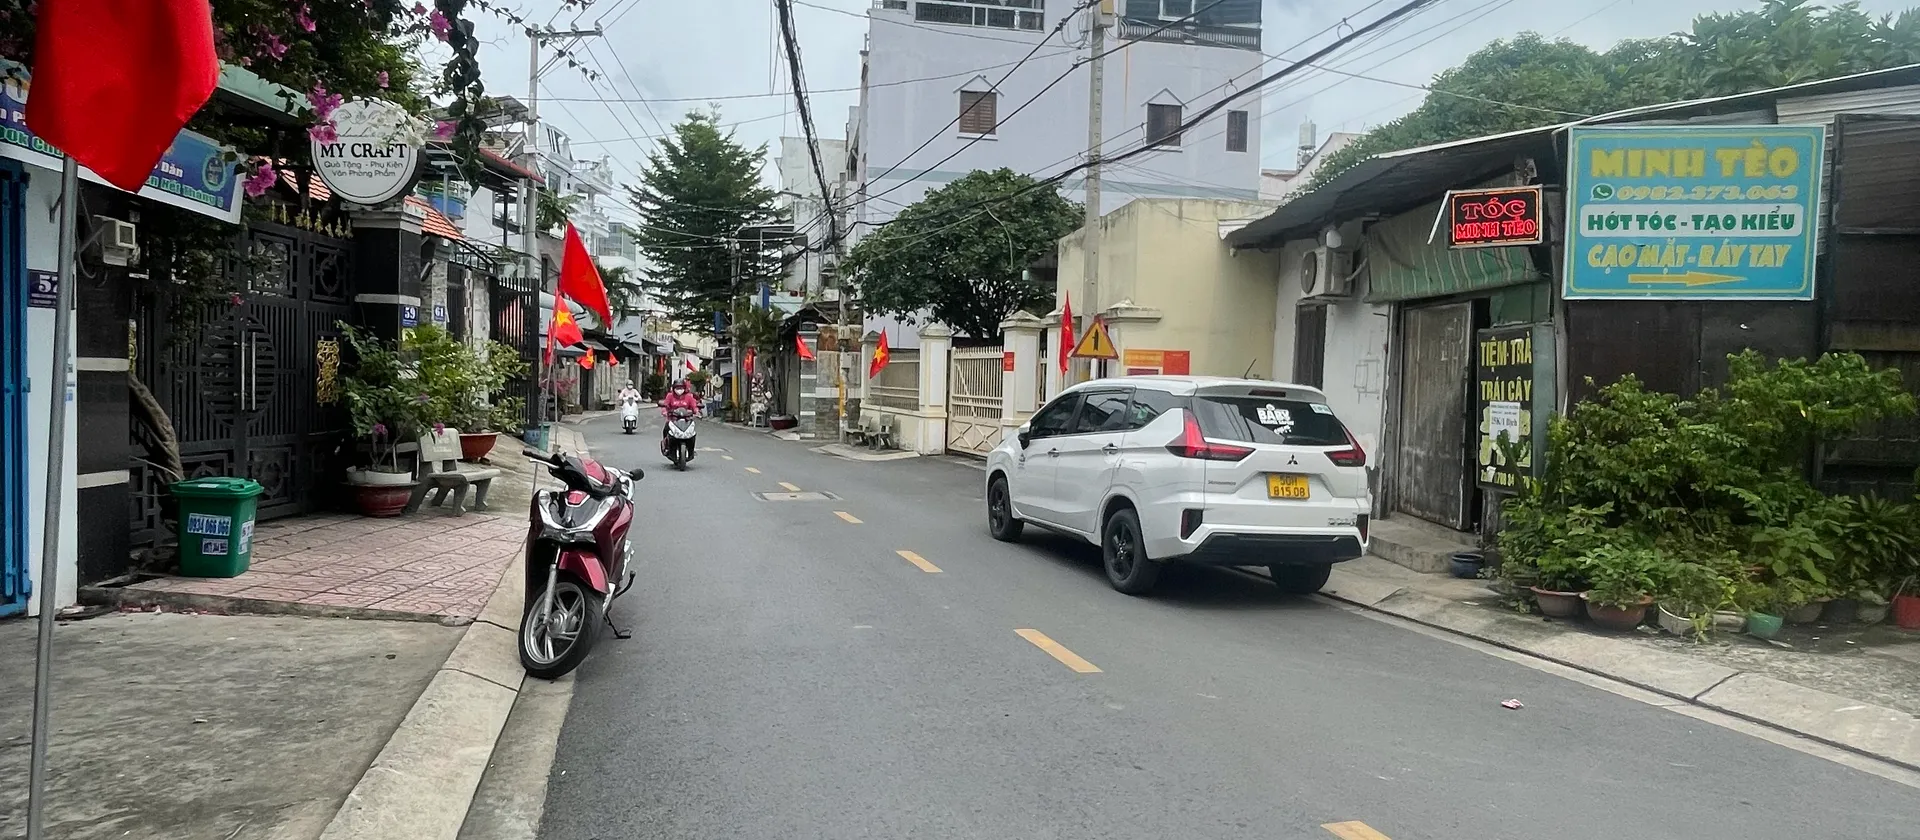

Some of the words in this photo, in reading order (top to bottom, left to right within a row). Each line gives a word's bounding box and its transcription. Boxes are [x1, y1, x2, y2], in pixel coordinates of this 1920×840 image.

[320, 143, 346, 158] MY
[350, 143, 407, 158] CRAFT
[1590, 148, 1706, 178] MINH
[1715, 138, 1799, 178] TÈO
[1616, 185, 1799, 201] 0982.373.063
[1461, 197, 1527, 219] TÓC
[1635, 210, 1677, 231] TÓC
[1691, 213, 1737, 234] TẠO
[1741, 205, 1795, 231] KIỂU
[1456, 221, 1500, 239] MINH
[1587, 243, 1637, 275] CẠO
[1748, 241, 1792, 268] TAY
[404, 306, 416, 319] 59
[434, 306, 443, 317] 61
[1480, 336, 1507, 372] TIỆM
[1510, 331, 1532, 365] TRÀ
[1480, 376, 1505, 401] TRÁI
[1507, 376, 1532, 401] CÂY
[1257, 409, 1290, 421] BABY
